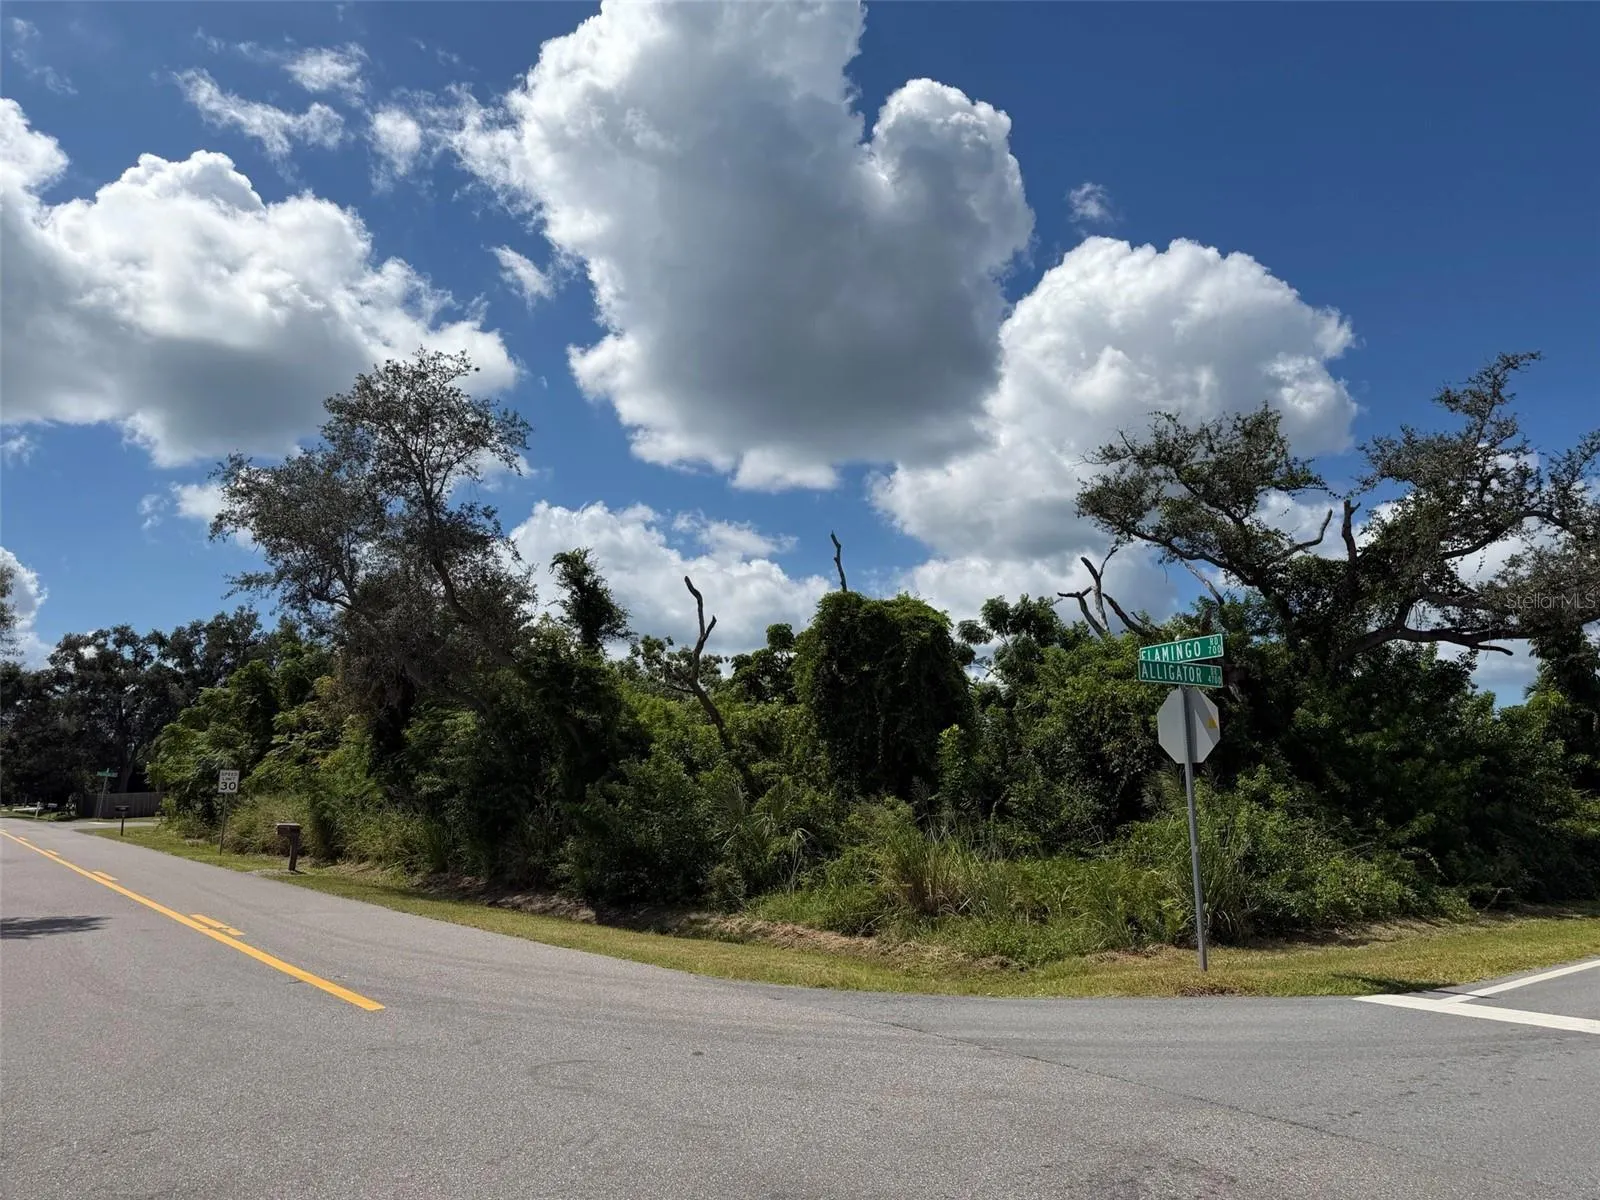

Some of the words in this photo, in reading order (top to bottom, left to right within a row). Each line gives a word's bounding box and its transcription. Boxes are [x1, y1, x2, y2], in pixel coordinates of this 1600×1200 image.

[1141, 641, 1201, 661] FLAMINGO
[1141, 663, 1202, 682] ALLIGATOR
[220, 781, 237, 791] 30
